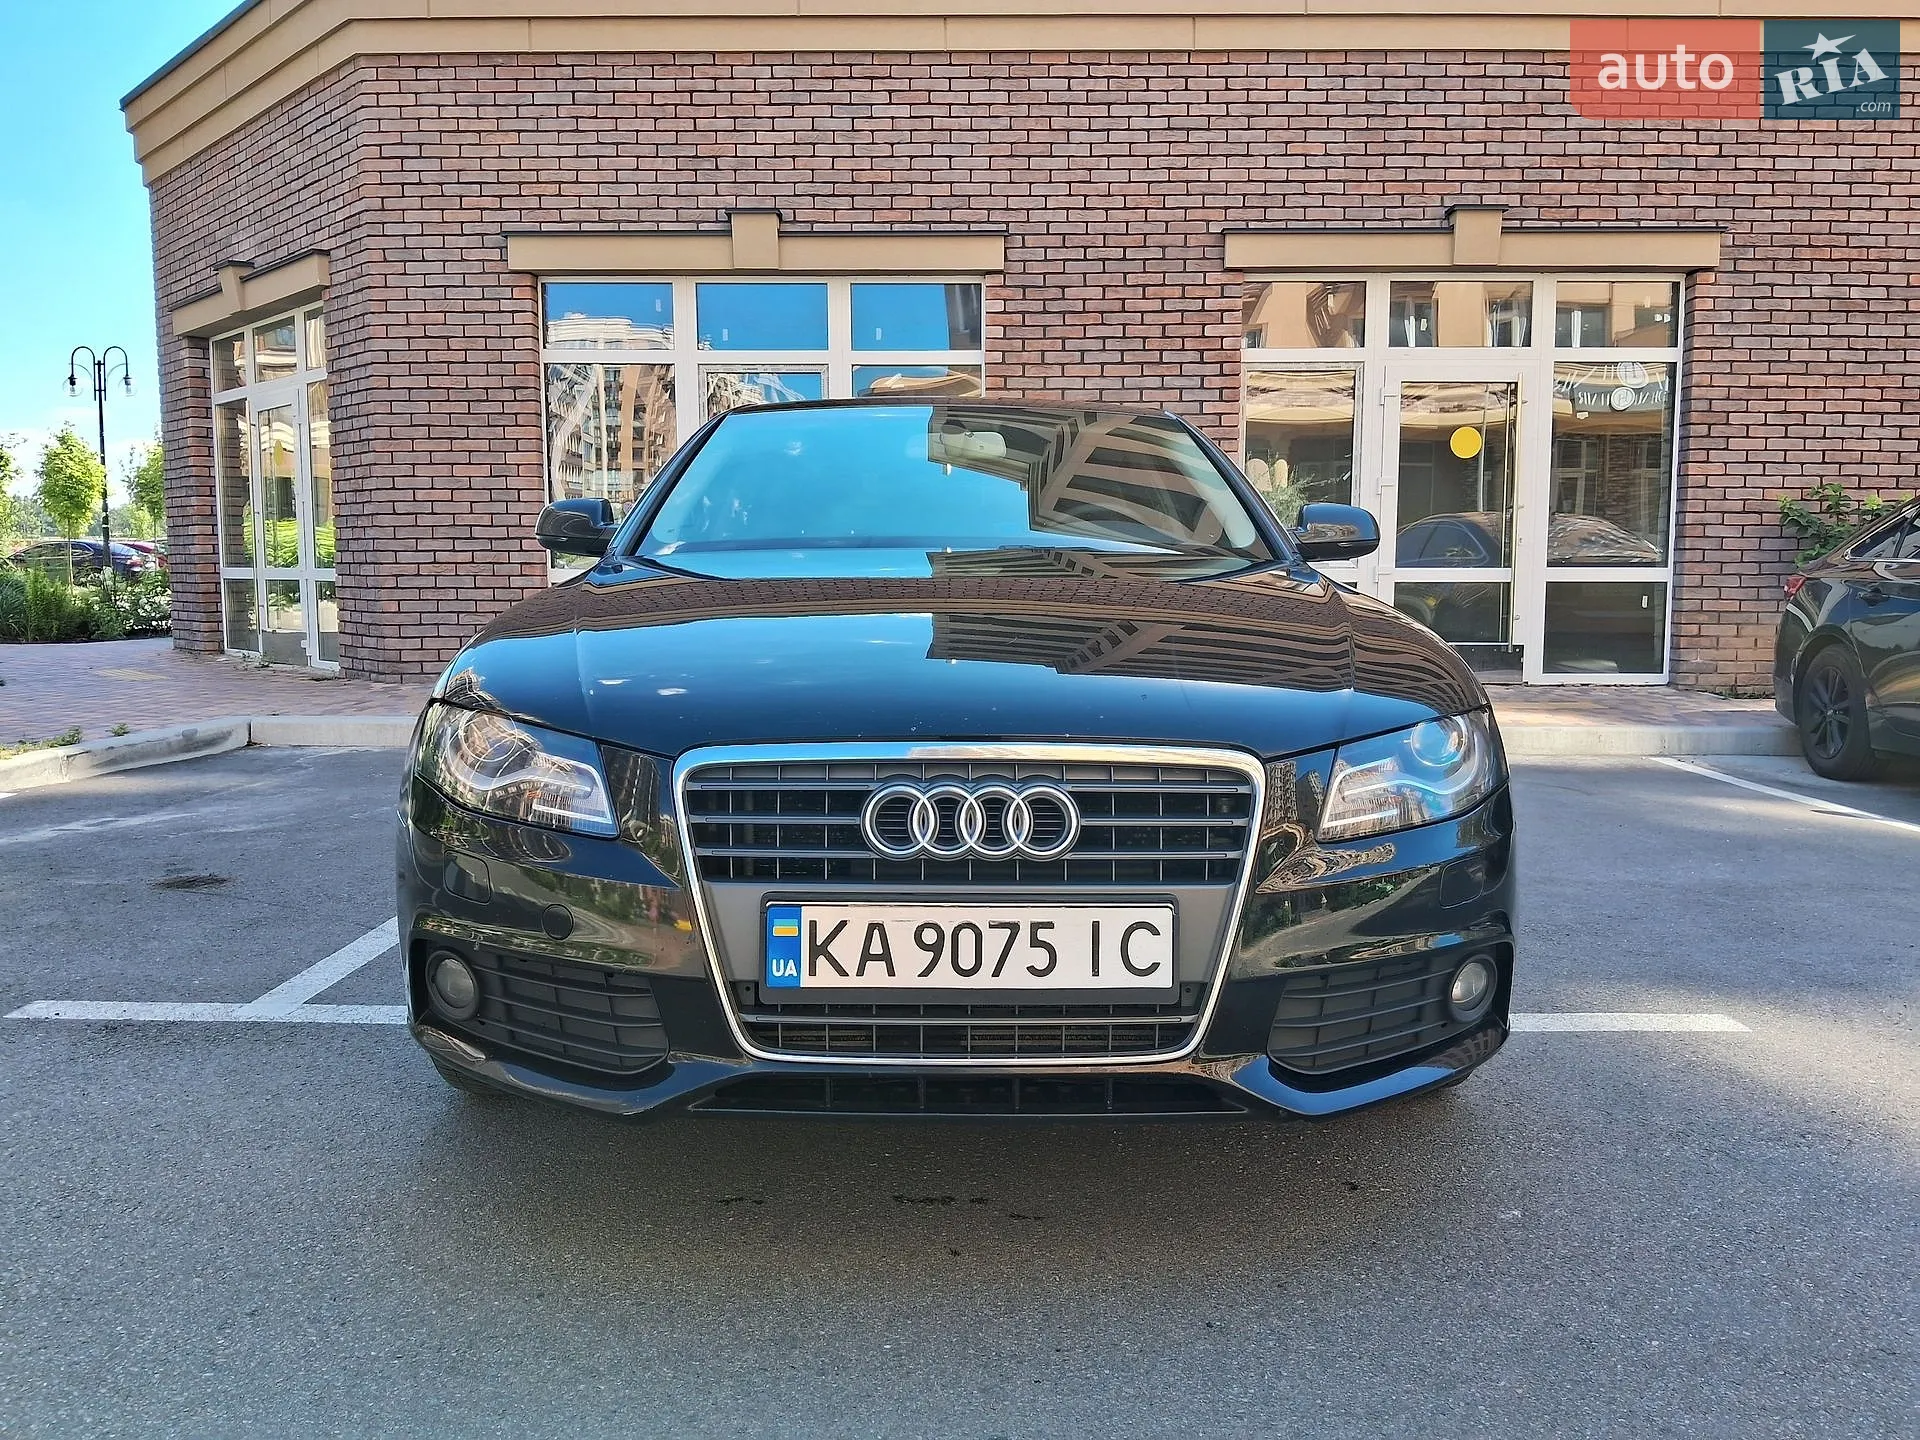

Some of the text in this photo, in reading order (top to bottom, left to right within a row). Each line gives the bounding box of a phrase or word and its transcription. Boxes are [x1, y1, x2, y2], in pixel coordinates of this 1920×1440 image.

[771, 959, 798, 977] UA
[808, 920, 1161, 978] KA 9075 IC
